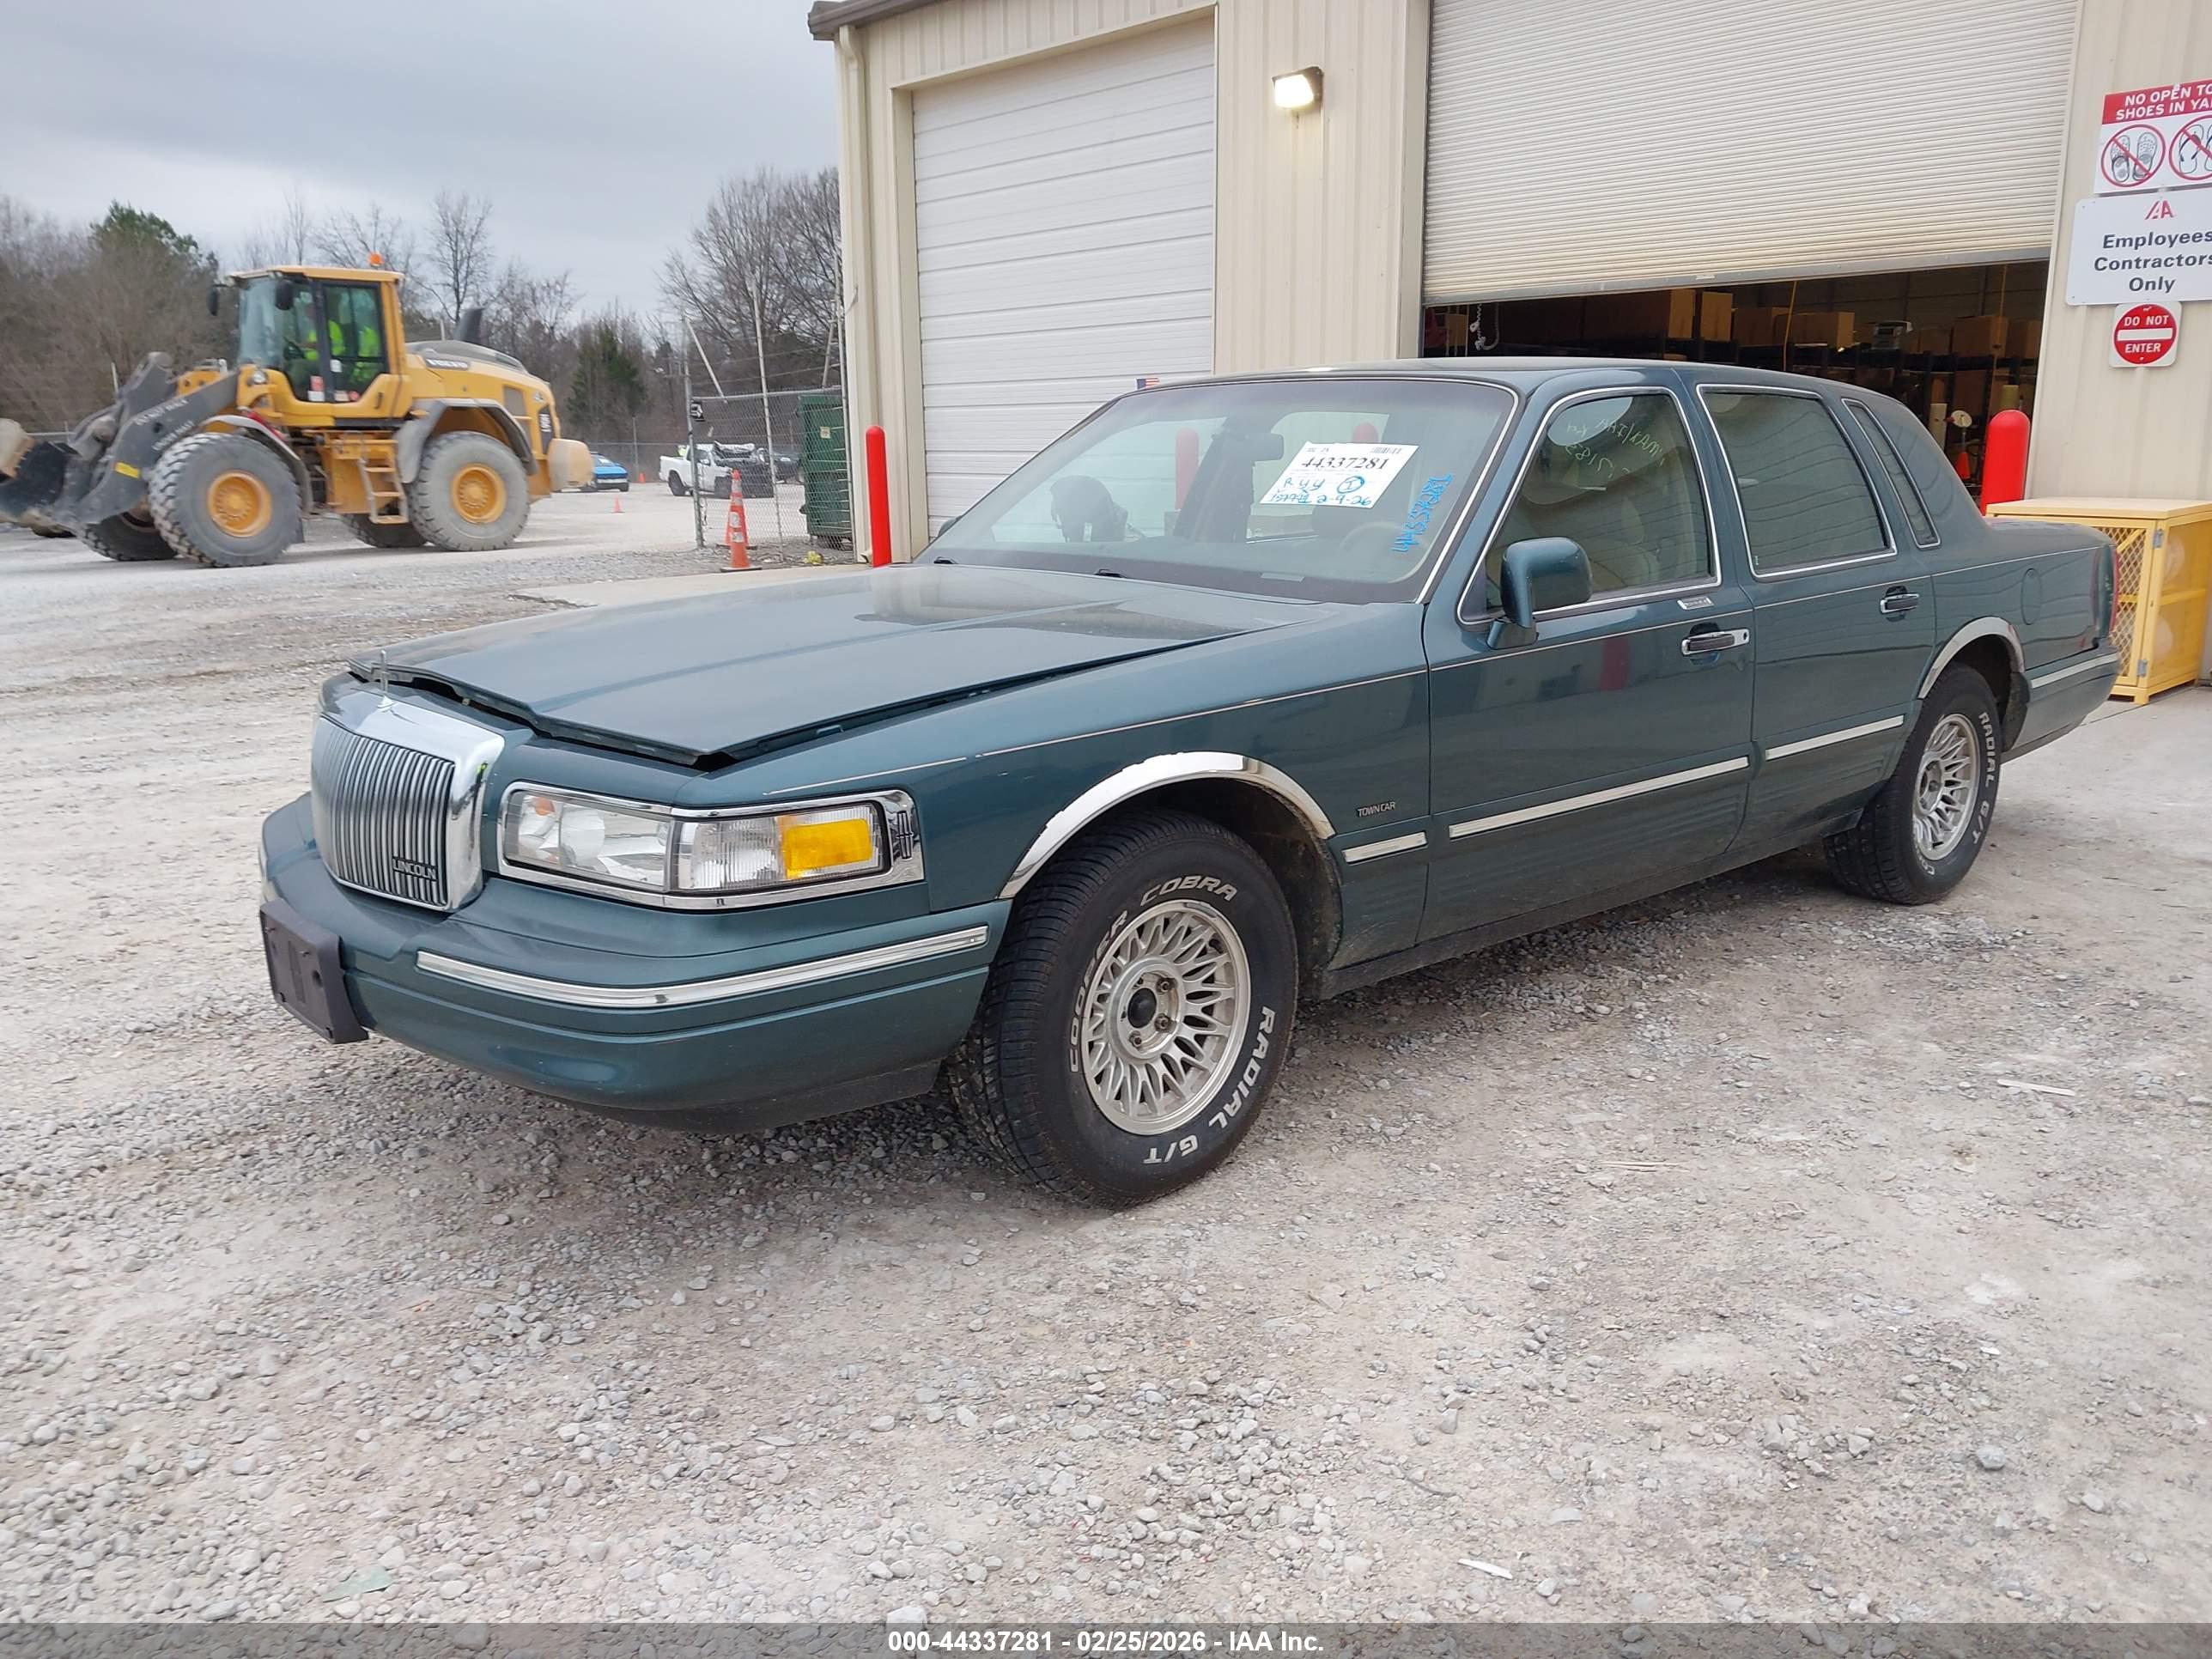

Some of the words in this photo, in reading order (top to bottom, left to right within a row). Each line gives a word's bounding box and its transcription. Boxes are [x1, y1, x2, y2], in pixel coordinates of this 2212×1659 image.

[2124, 94, 2146, 106] NO
[2150, 87, 2191, 102] OPEN
[2116, 104, 2164, 120] SHOES
[2169, 101, 2185, 113] IN
[2191, 97, 2212, 110] YA
[2103, 231, 2212, 251] Employees
[2129, 276, 2176, 293] Only
[2124, 316, 2141, 326] DO
[2146, 314, 2169, 325] NOT
[2124, 343, 2161, 354] ENTER
[1302, 456, 1389, 470] 44337281
[1978, 712, 1996, 788] RADIAL
[392, 858, 437, 882] LINCOLN
[1140, 876, 1237, 907] COBRA
[1208, 1006, 1276, 1129] RADIAL
[1143, 1134, 1199, 1164] G/T
